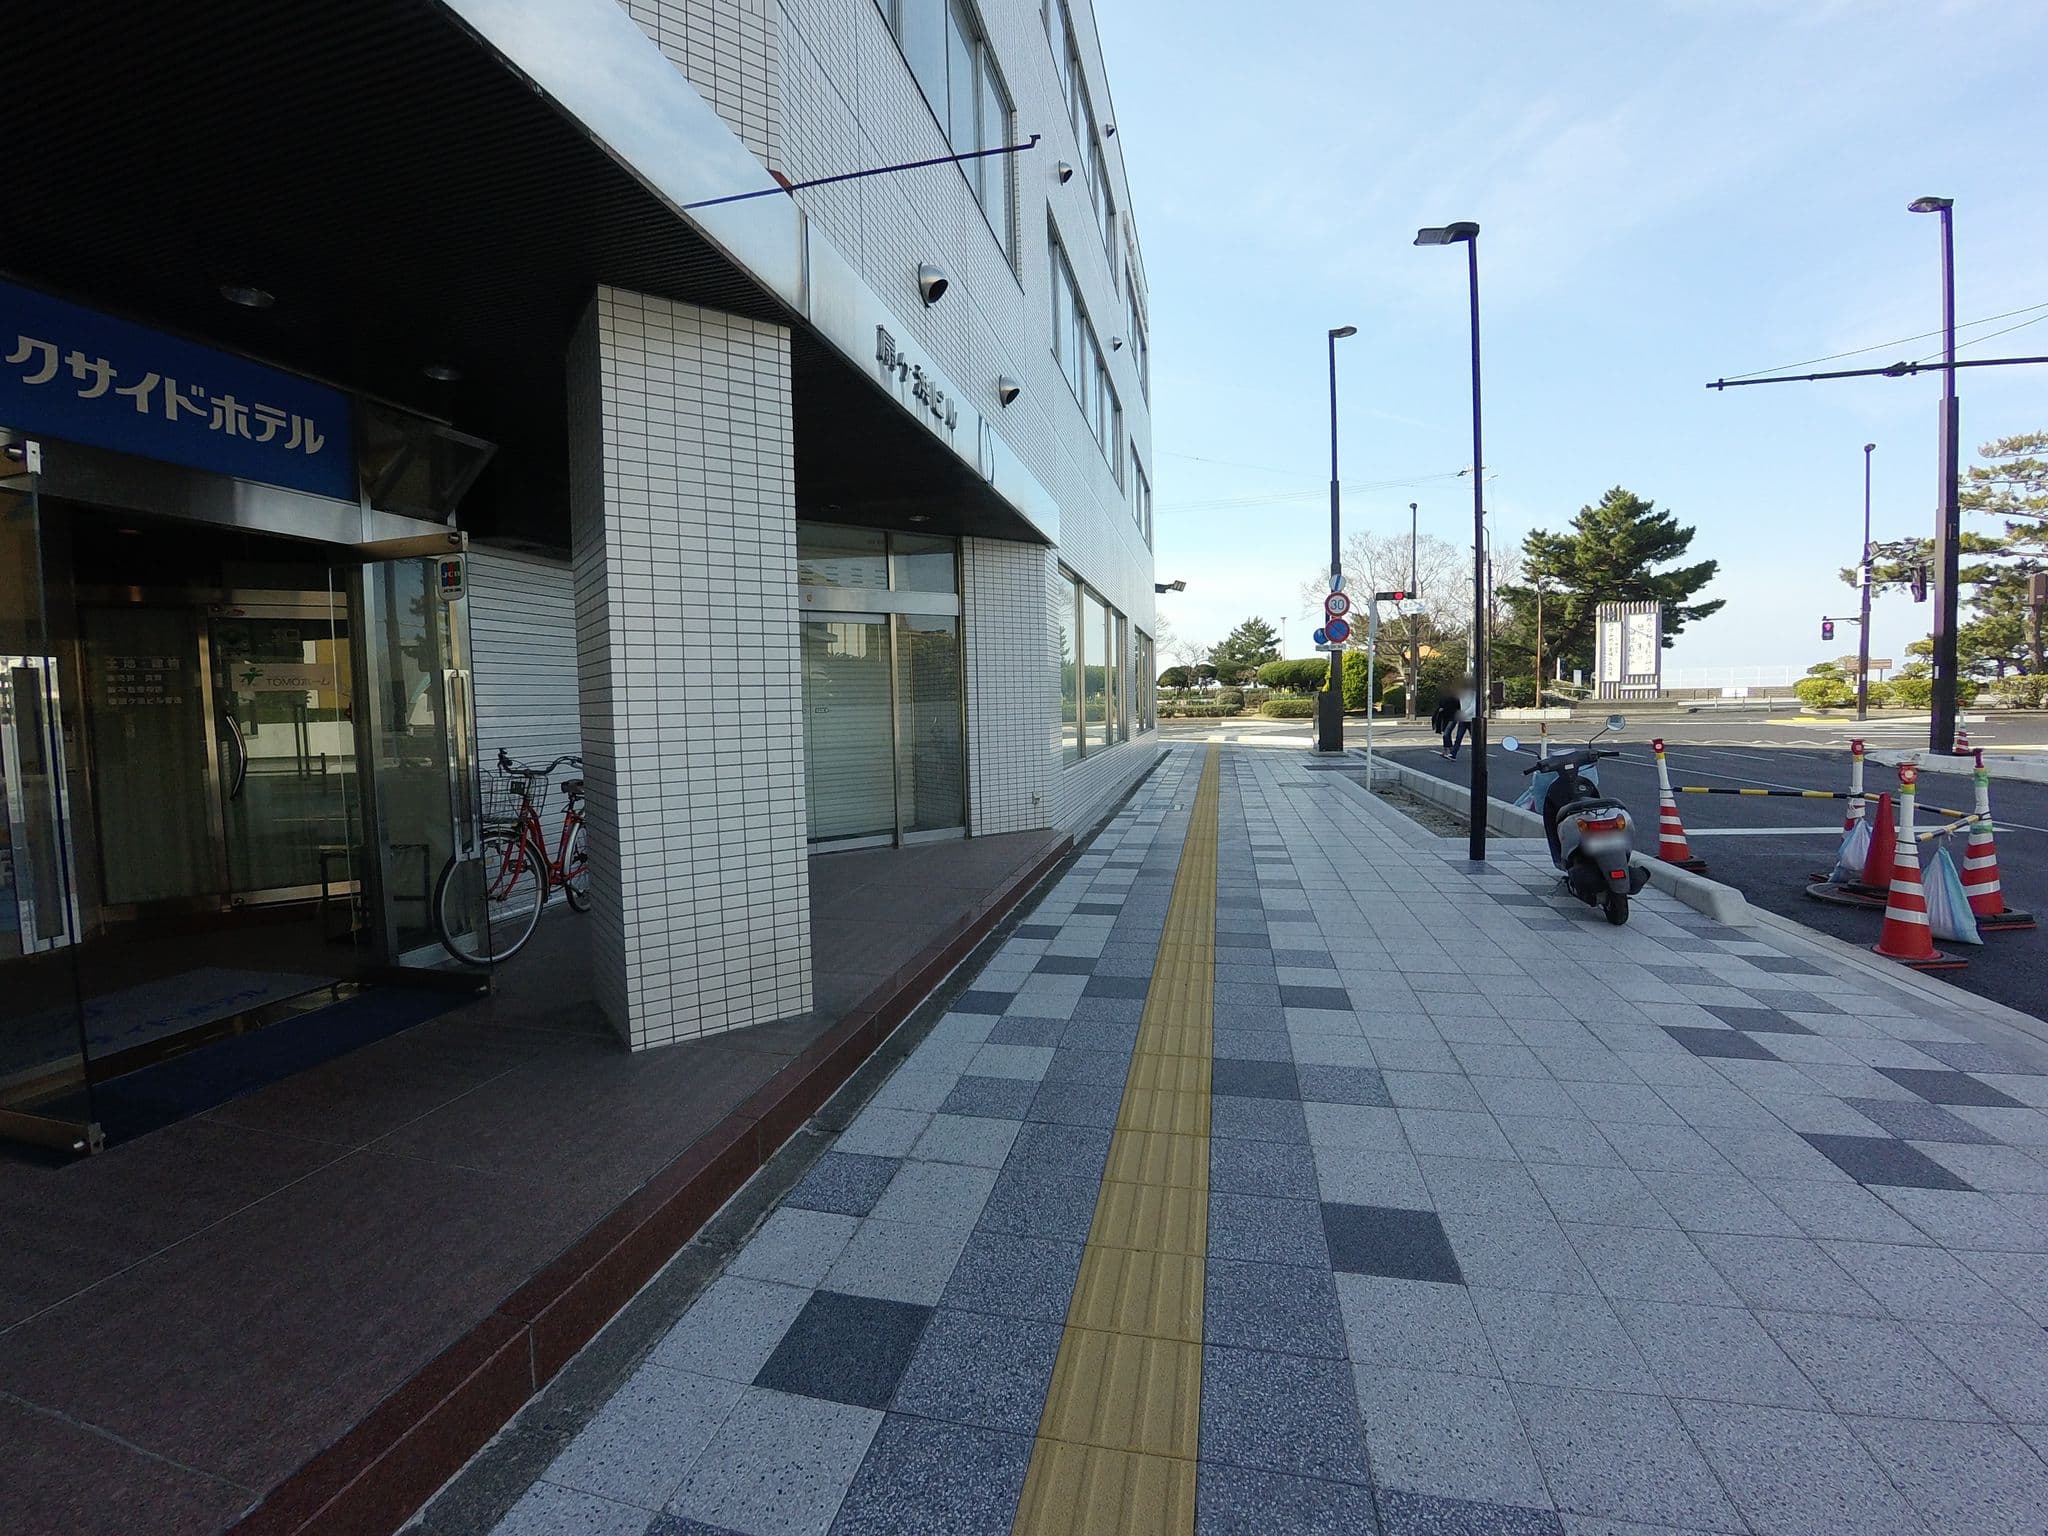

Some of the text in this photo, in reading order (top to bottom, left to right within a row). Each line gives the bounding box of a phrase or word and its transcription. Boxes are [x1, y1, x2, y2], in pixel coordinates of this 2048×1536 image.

[5, 335, 325, 455] クサイドホテル
[1330, 599, 1345, 610] 30
